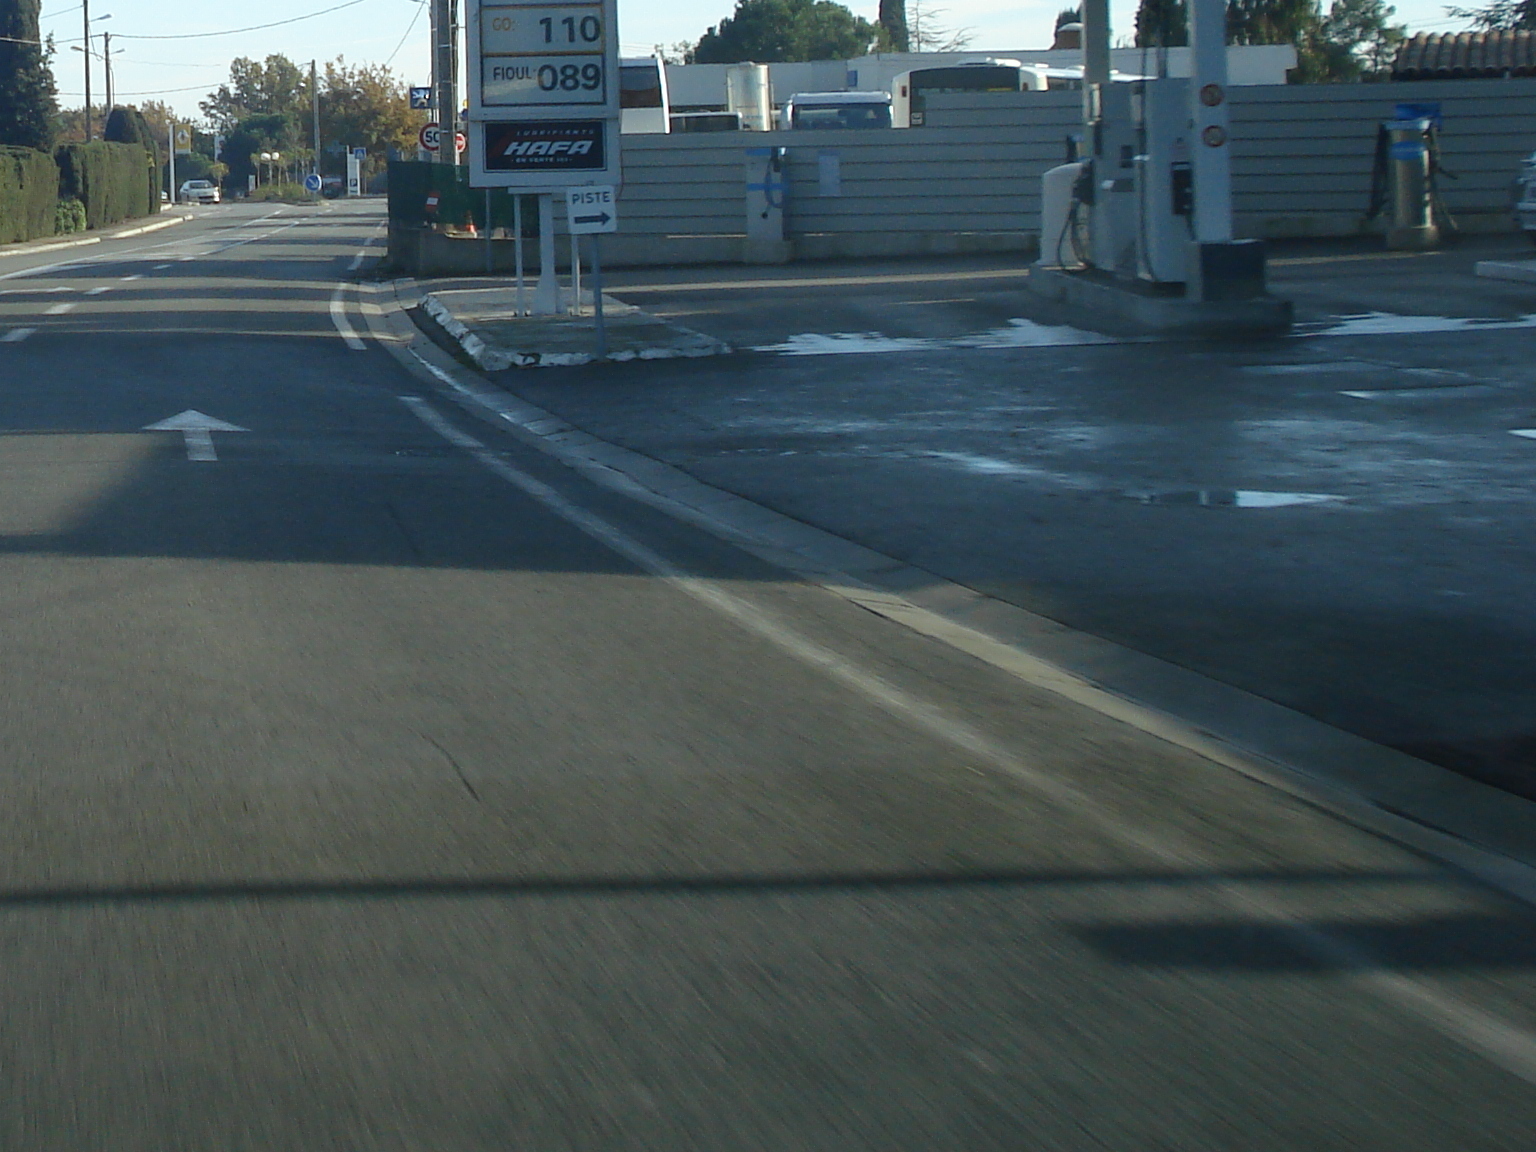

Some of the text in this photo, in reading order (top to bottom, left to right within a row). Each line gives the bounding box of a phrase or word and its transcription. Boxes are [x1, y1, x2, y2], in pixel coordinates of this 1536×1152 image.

[539, 15, 601, 44] 110
[503, 140, 594, 156] HAFA
[572, 191, 611, 205] PISTE
